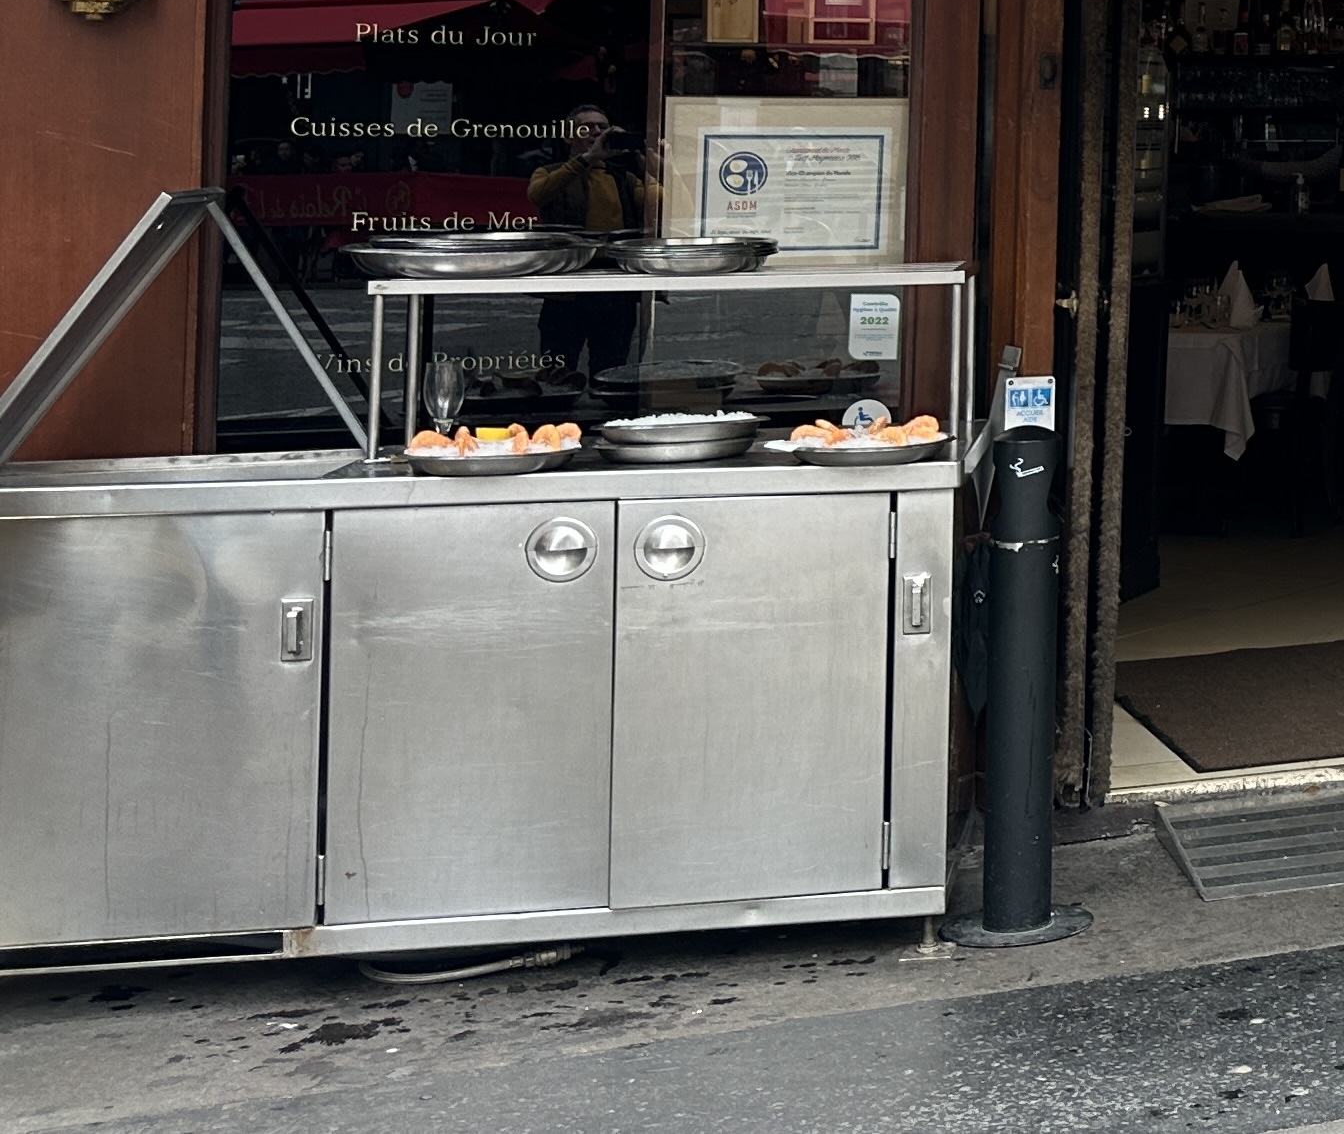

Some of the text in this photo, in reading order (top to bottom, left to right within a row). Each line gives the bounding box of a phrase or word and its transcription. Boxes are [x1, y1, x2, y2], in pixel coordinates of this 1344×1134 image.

[355, 22, 538, 46] Plats du Jour
[290, 116, 591, 140] Cuisses de Grenouille
[726, 200, 758, 211] ASOM
[350, 211, 540, 232] Fruits de Mer
[860, 316, 889, 325] 2022
[432, 350, 567, 374] Propriétés
